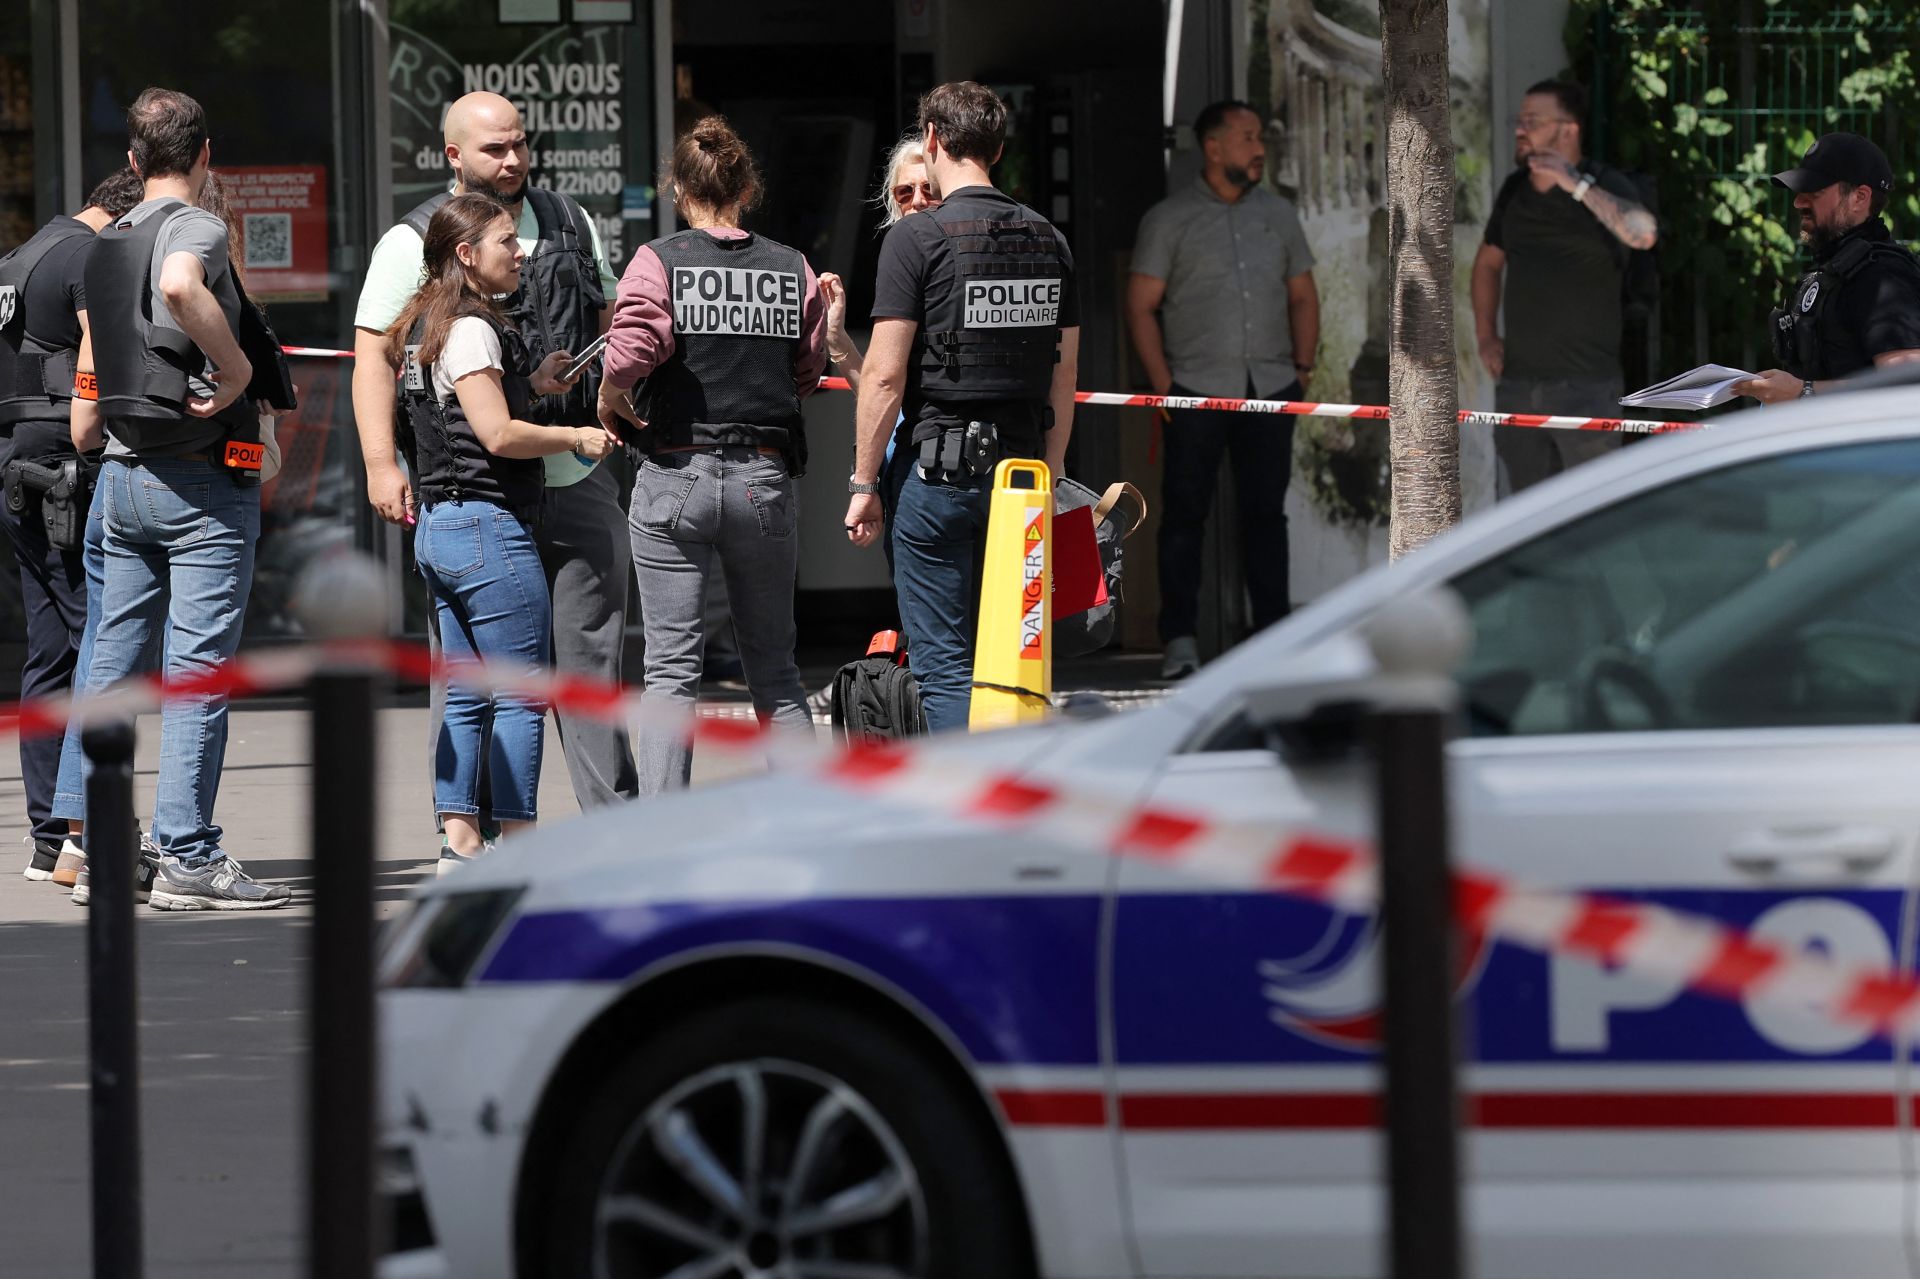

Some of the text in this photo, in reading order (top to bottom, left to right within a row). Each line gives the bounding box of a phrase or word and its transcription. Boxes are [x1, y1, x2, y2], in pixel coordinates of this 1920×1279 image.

[464, 63, 622, 95] NOUS VOUS
[415, 145, 444, 170] du
[543, 144, 621, 169] samedi
[555, 171, 622, 195] 22h00
[675, 269, 798, 306] POLICE
[968, 284, 1060, 306] POLICE
[676, 305, 798, 336] JUDICIAIRE
[966, 308, 1059, 324] JUDICIAIRE
[1145, 396, 1288, 413] POLICE NATIONALE
[1601, 421, 1656, 433] POLICE
[229, 447, 263, 463] POLI
[1023, 554, 1043, 648] DANGER
